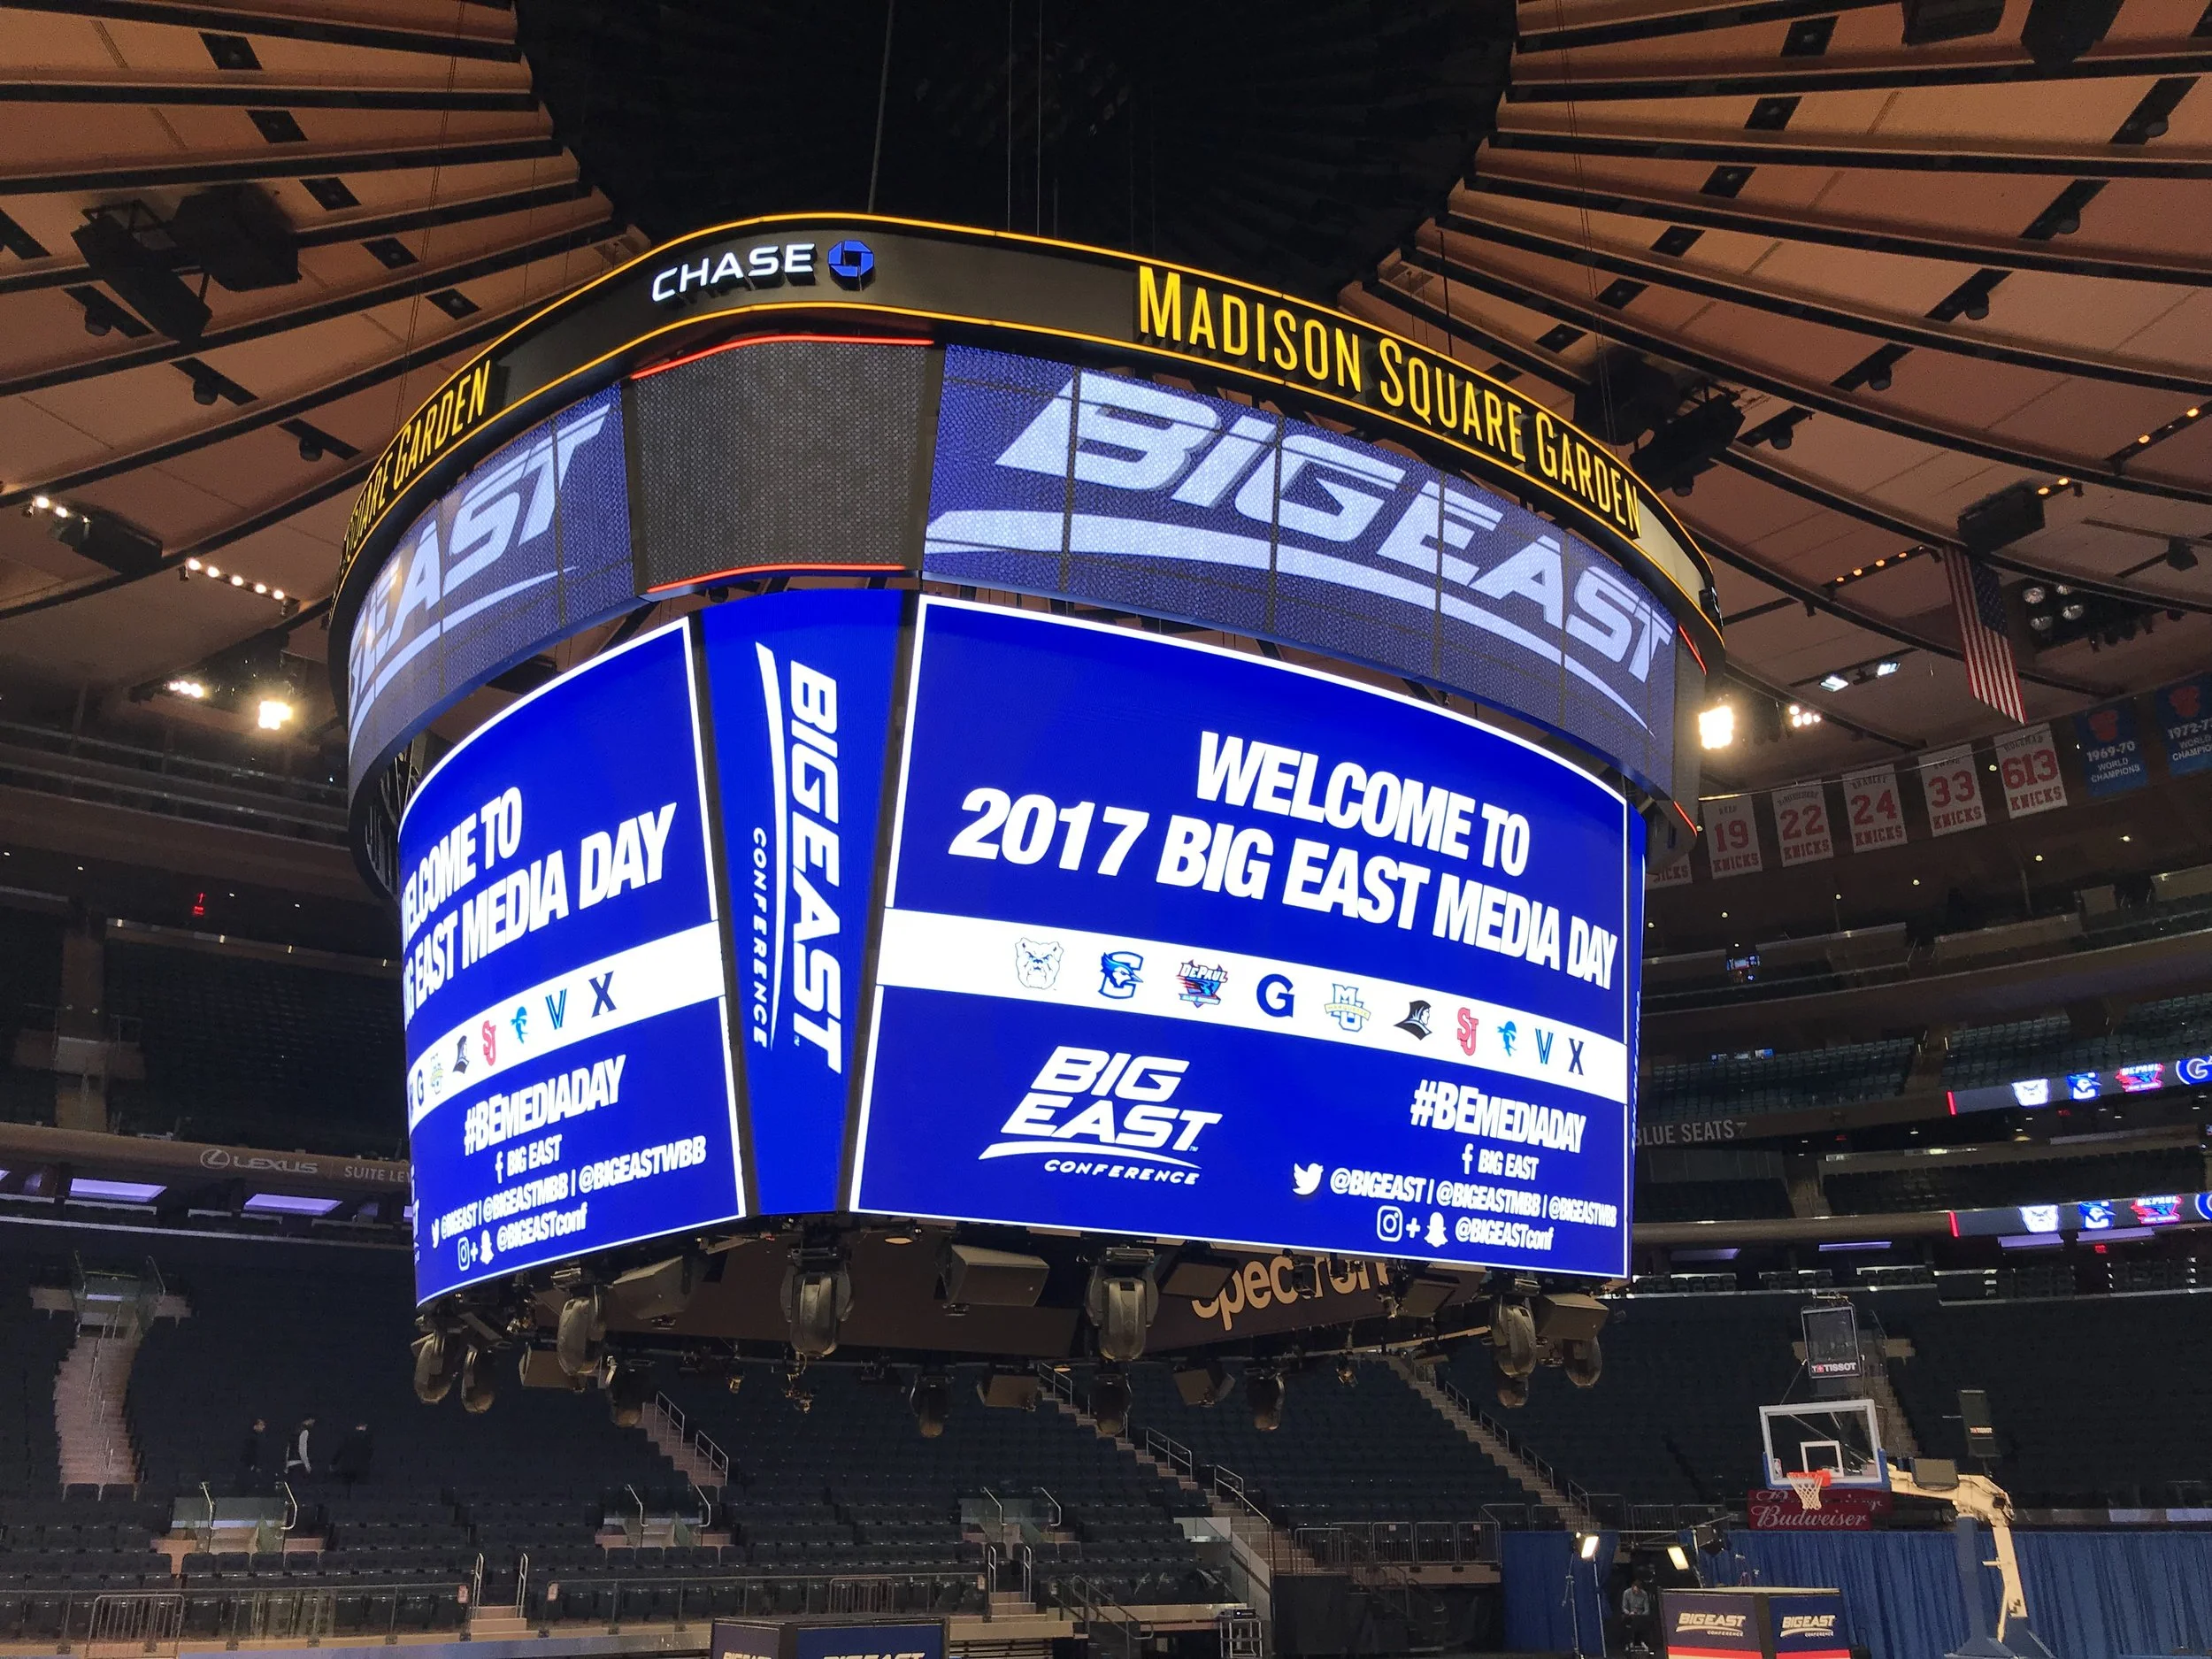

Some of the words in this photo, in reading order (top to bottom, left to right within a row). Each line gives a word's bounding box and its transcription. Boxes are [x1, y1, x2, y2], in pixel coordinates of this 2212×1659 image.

[651, 242, 816, 303] CHASE
[1138, 265, 1363, 393] MADISON
[1379, 337, 1525, 462] SQUARE
[1535, 411, 1642, 539] GARDEN
[393, 359, 490, 490] GARDEN
[361, 403, 611, 695] EAST
[2001, 749, 2058, 790] 613
[2086, 741, 2136, 762] 1969-70
[2098, 757, 2129, 772] WORLD
[2172, 744, 2212, 761] CHAMPIO
[1928, 771, 1975, 808] 33
[2091, 764, 2140, 783] CHAMPIONS
[1197, 731, 1475, 860] WELCOME
[1482, 803, 1530, 876] TO
[1851, 789, 1897, 826] 24
[2009, 786, 2062, 811] KNICKS
[480, 787, 522, 870] TO
[1714, 819, 1749, 853] 19
[1779, 804, 1824, 841] 22
[1855, 825, 1902, 847] KNICKS
[1932, 806, 1982, 830] KNICKS
[1712, 853, 1759, 872] KNICKS
[1783, 839, 1830, 860] KNICKS
[948, 787, 1149, 876] 2017
[1156, 815, 1274, 900] BIG
[1282, 838, 1431, 930] EAST
[1432, 872, 1561, 971] MEDIA
[1568, 916, 1617, 991] DAY
[1653, 864, 1689, 883] ICKS
[415, 910, 458, 1010] EAST
[462, 849, 569, 970] MEDIA
[579, 803, 677, 910] DAY
[753, 827, 767, 1048] CONFERENCE
[1256, 974, 1294, 1018] G
[1031, 1045, 1189, 1102] BIG
[465, 1055, 626, 1156] #BEMEDIADAY
[1001, 1092, 1224, 1151] EAST
[1410, 1079, 1586, 1153] #BEMEDIADAY
[1635, 1125, 1676, 1146] BLUE
[1681, 1119, 1735, 1142] SEATS
[234, 1156, 319, 1174] LEXUS
[344, 1165, 385, 1181] SUITE
[507, 1145, 527, 1177] BIG
[528, 1133, 563, 1171] EAST
[1044, 1159, 1200, 1185] CONFERENCE
[1479, 1149, 1504, 1176] BIG
[1505, 1155, 1539, 1180] EAST
[483, 1172, 569, 1222] @BIGEASTMBB
[579, 1135, 707, 1194] @BIGEASTWBB
[1330, 1168, 1426, 1203] @BIGEAST
[1436, 1180, 1541, 1218] @BIGEASTMBB
[1548, 1194, 1617, 1228] @BIGEASTWBB
[496, 1202, 588, 1252] @BIGEASTconf
[1455, 1217, 1554, 1251] @BIGEASTconf
[1191, 1256, 1391, 1331] pecru
[1824, 1362, 1857, 1372] TISSOT
[1751, 1505, 1867, 1528] Budweiser
